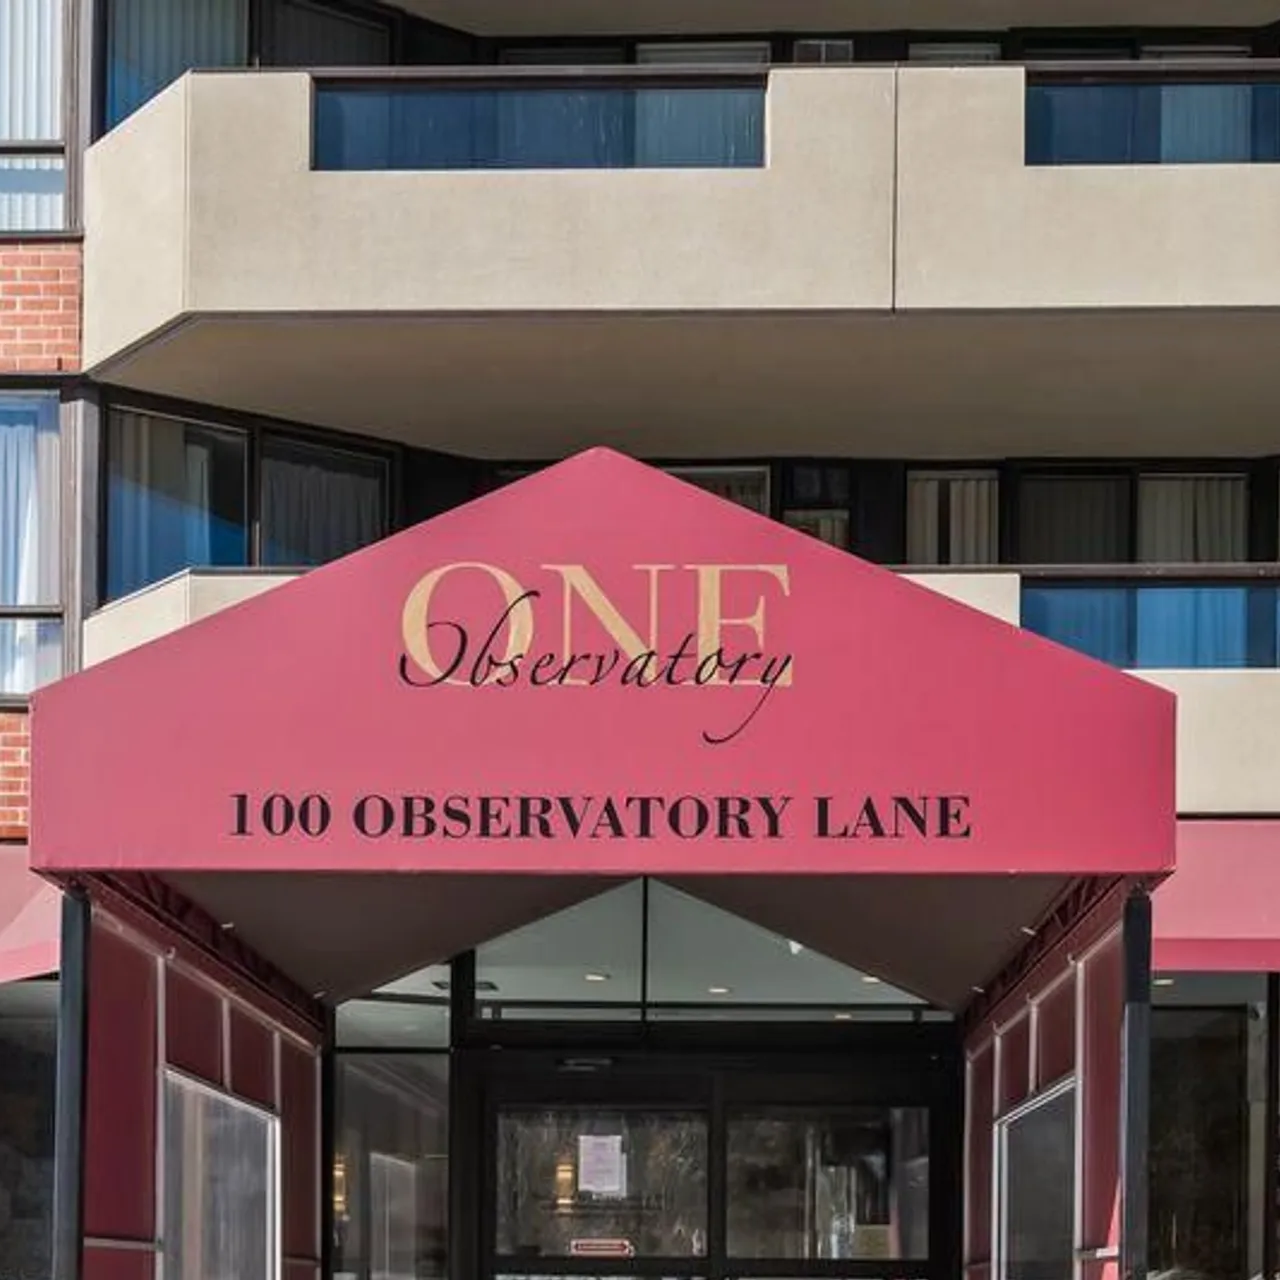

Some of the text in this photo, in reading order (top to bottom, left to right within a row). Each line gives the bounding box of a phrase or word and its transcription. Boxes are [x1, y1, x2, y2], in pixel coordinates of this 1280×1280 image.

[398, 590, 793, 745] Observatory
[400, 561, 793, 687] ONE
[229, 793, 972, 839] 100 OBSERVATORY LANE
